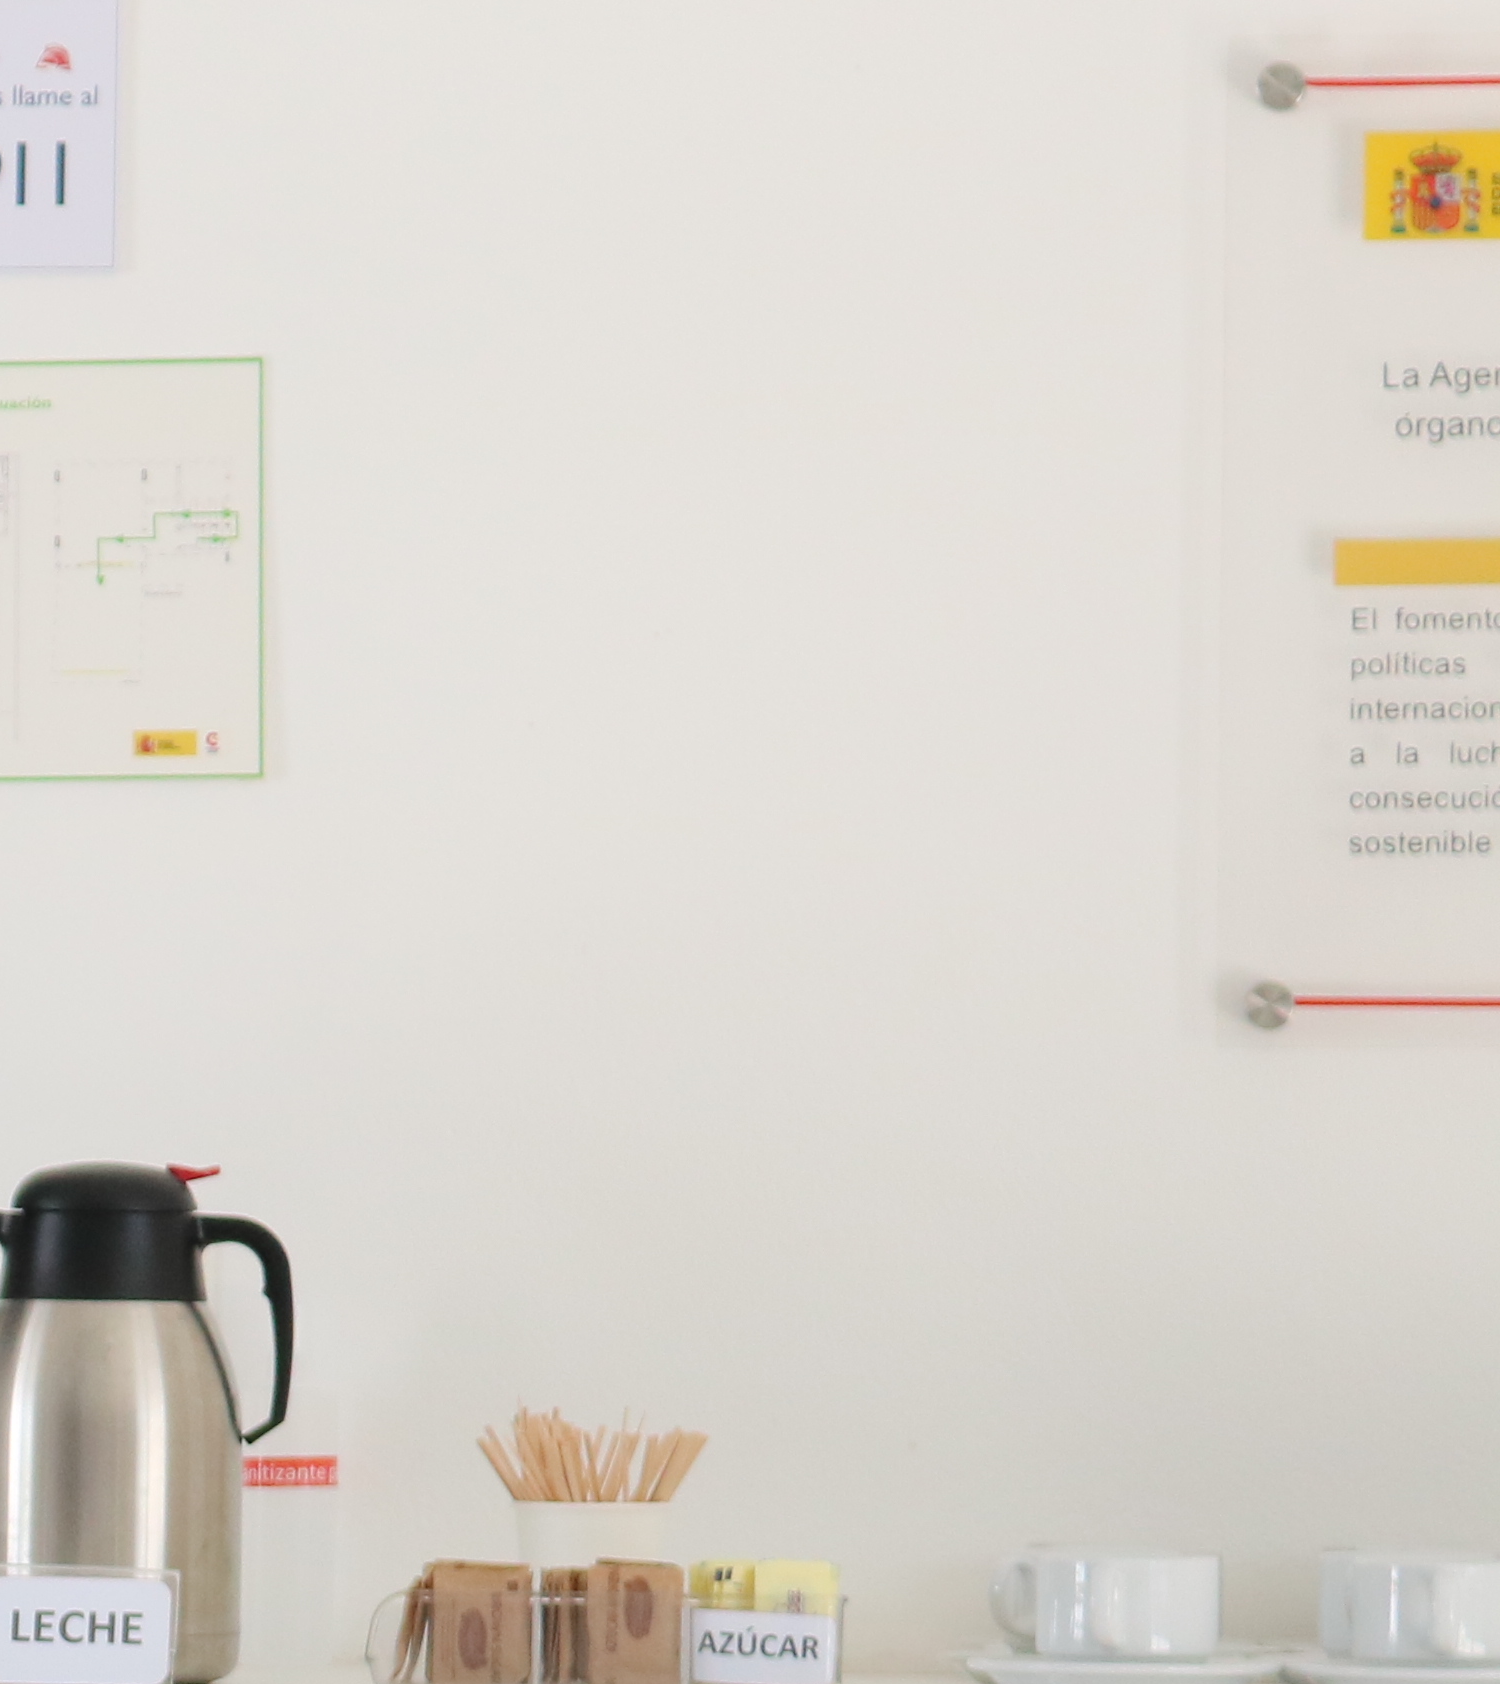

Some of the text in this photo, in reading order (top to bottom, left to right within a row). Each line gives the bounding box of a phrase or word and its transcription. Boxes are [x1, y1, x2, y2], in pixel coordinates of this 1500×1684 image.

[12, 84, 72, 107] llame
[81, 84, 99, 107] al
[1383, 361, 1419, 387] La
[1351, 607, 1377, 630] El
[1351, 652, 1466, 681] políticas
[1350, 746, 1365, 764] a
[1396, 741, 1419, 764] la
[1349, 830, 1491, 853] sostenible
[11, 1608, 143, 1645] LECHE
[697, 1626, 819, 1659] AZÚCAR
